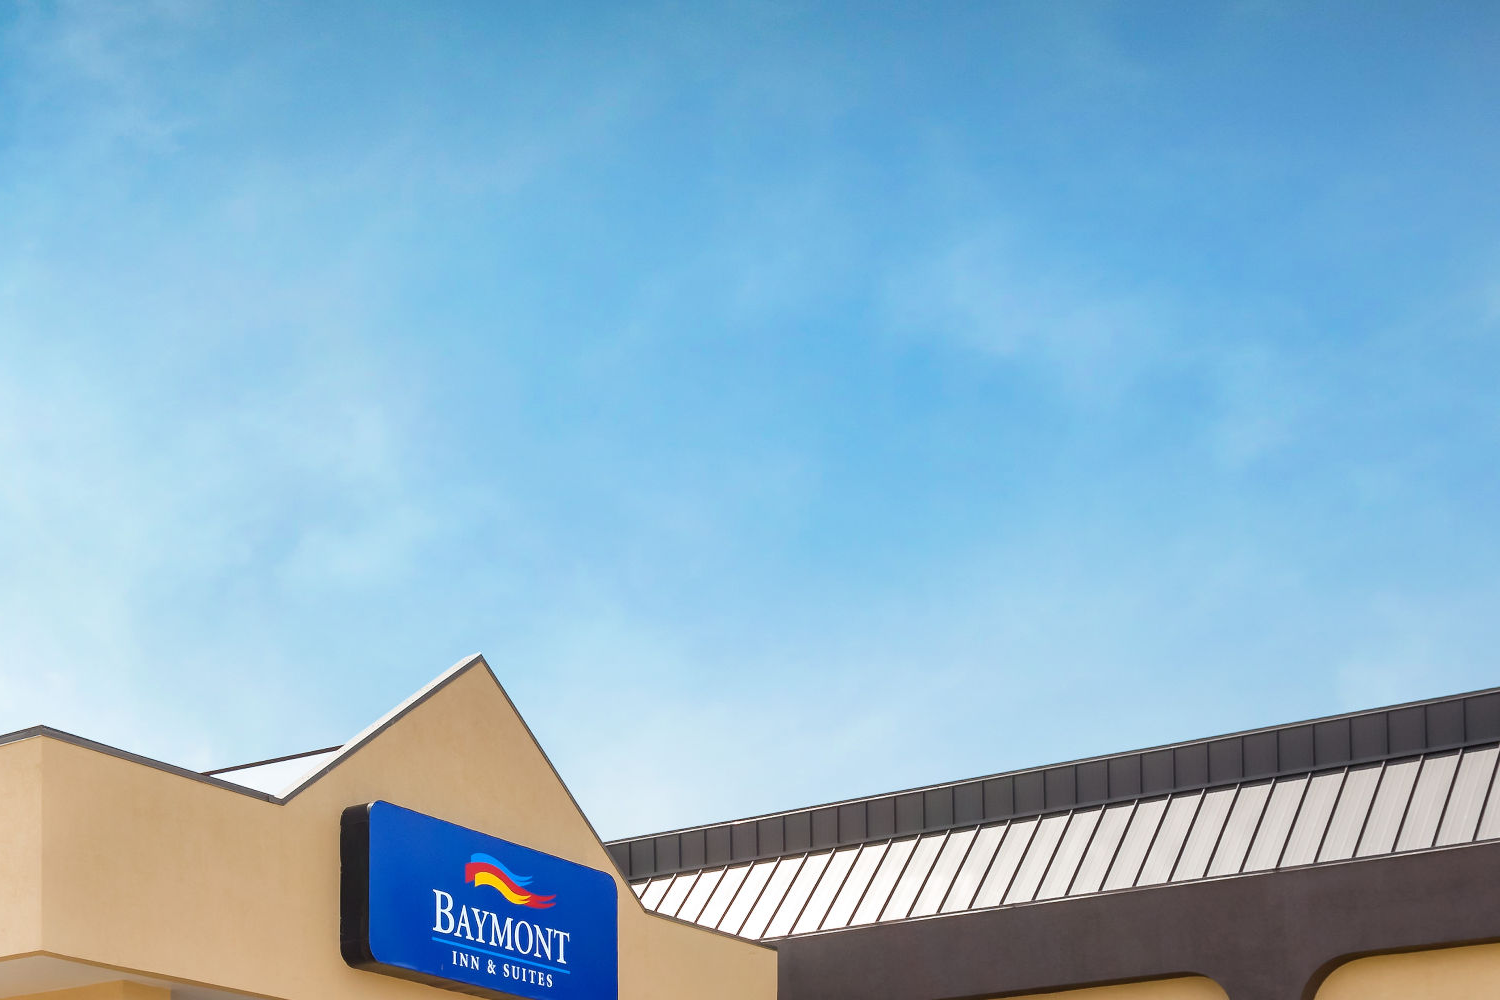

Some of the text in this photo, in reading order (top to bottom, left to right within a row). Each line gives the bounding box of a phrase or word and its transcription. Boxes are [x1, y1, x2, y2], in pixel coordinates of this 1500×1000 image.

[432, 888, 570, 964] BAYMONT
[452, 950, 553, 988] INN & SUITES
